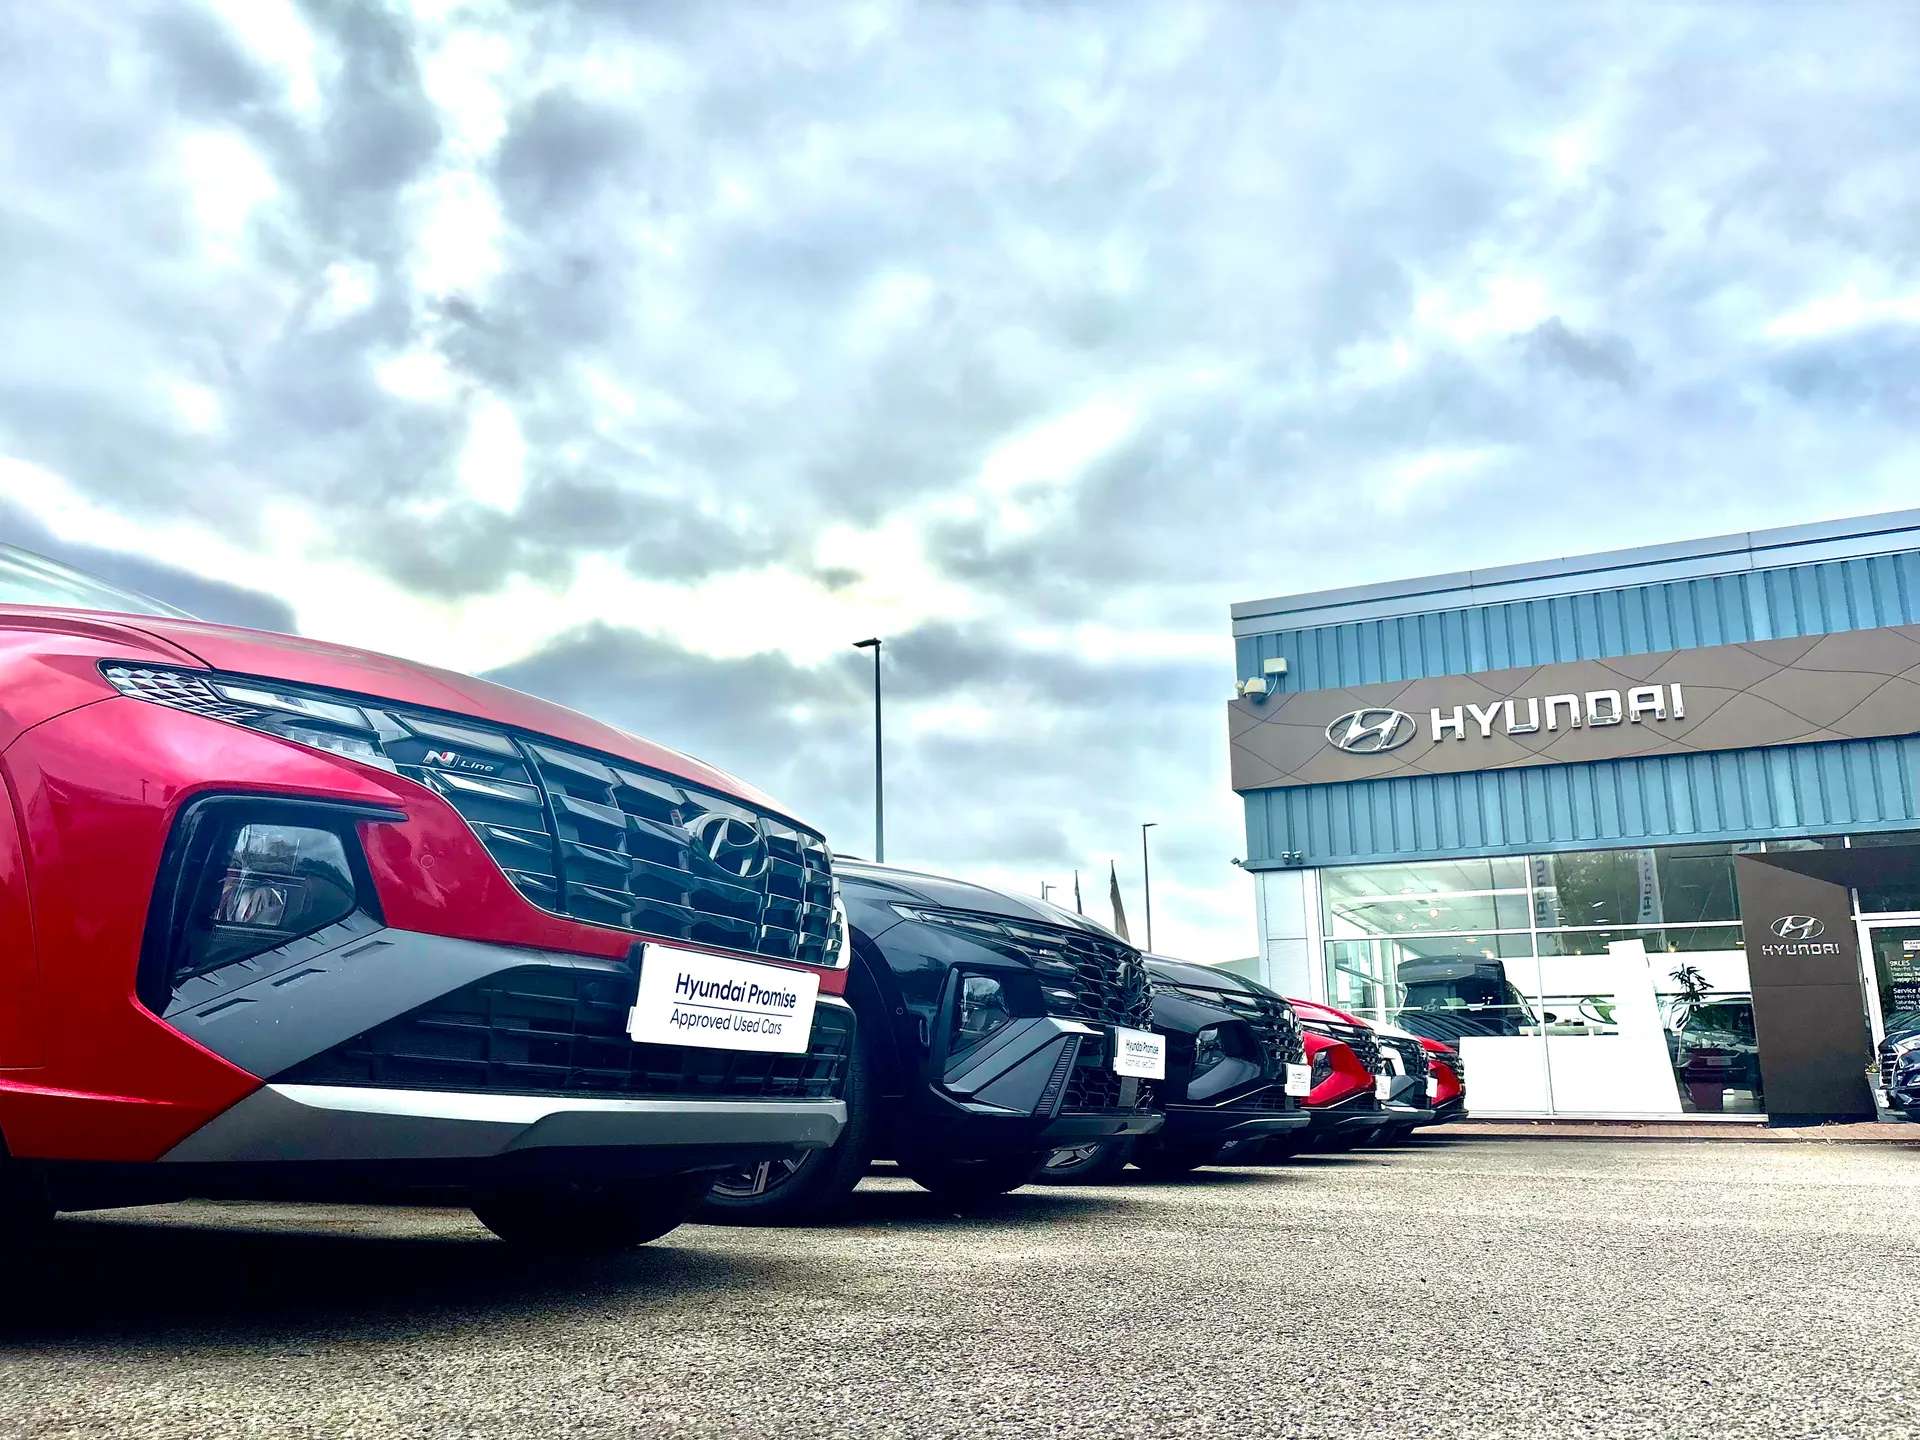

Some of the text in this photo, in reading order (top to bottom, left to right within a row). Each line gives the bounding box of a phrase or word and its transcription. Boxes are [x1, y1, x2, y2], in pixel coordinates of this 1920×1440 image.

[1430, 682, 1685, 742] HYUNDAI
[423, 750, 494, 772] N Line
[1762, 943, 1840, 956] HYUNDAI
[676, 972, 797, 1008] Hyundai Promise
[670, 1008, 782, 1035] Approved Used Cars
